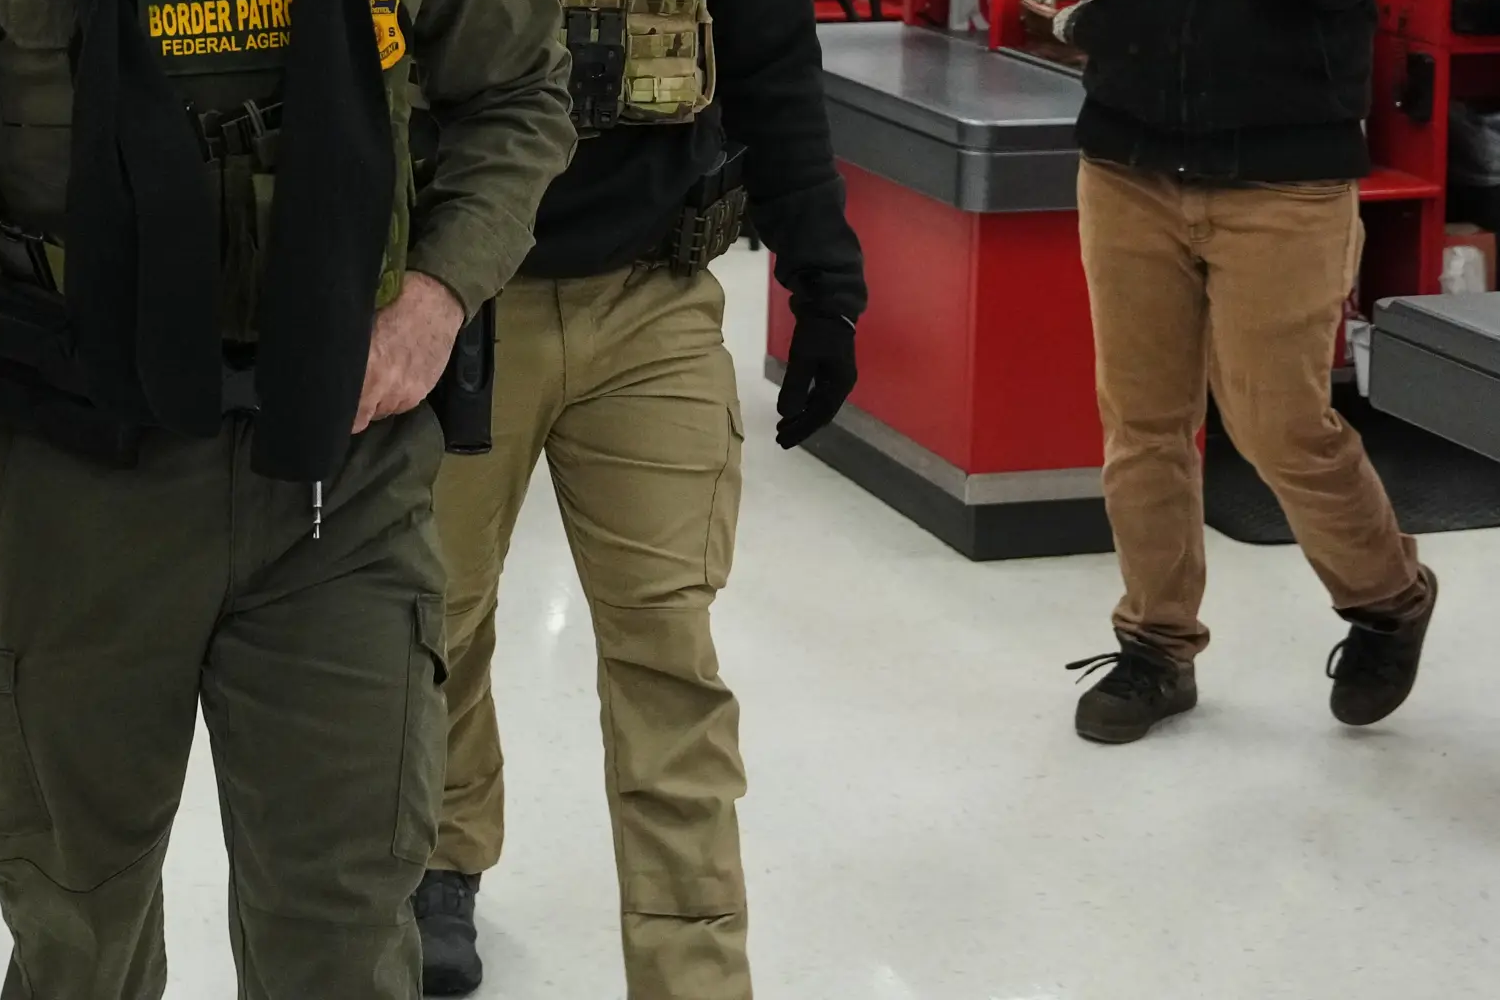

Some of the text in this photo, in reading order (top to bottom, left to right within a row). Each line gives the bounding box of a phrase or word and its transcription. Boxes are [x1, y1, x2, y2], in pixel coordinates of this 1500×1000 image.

[148, 0, 233, 38] BORDER
[388, 26, 396, 37] S
[162, 32, 290, 56] FEDERAL AGEN
